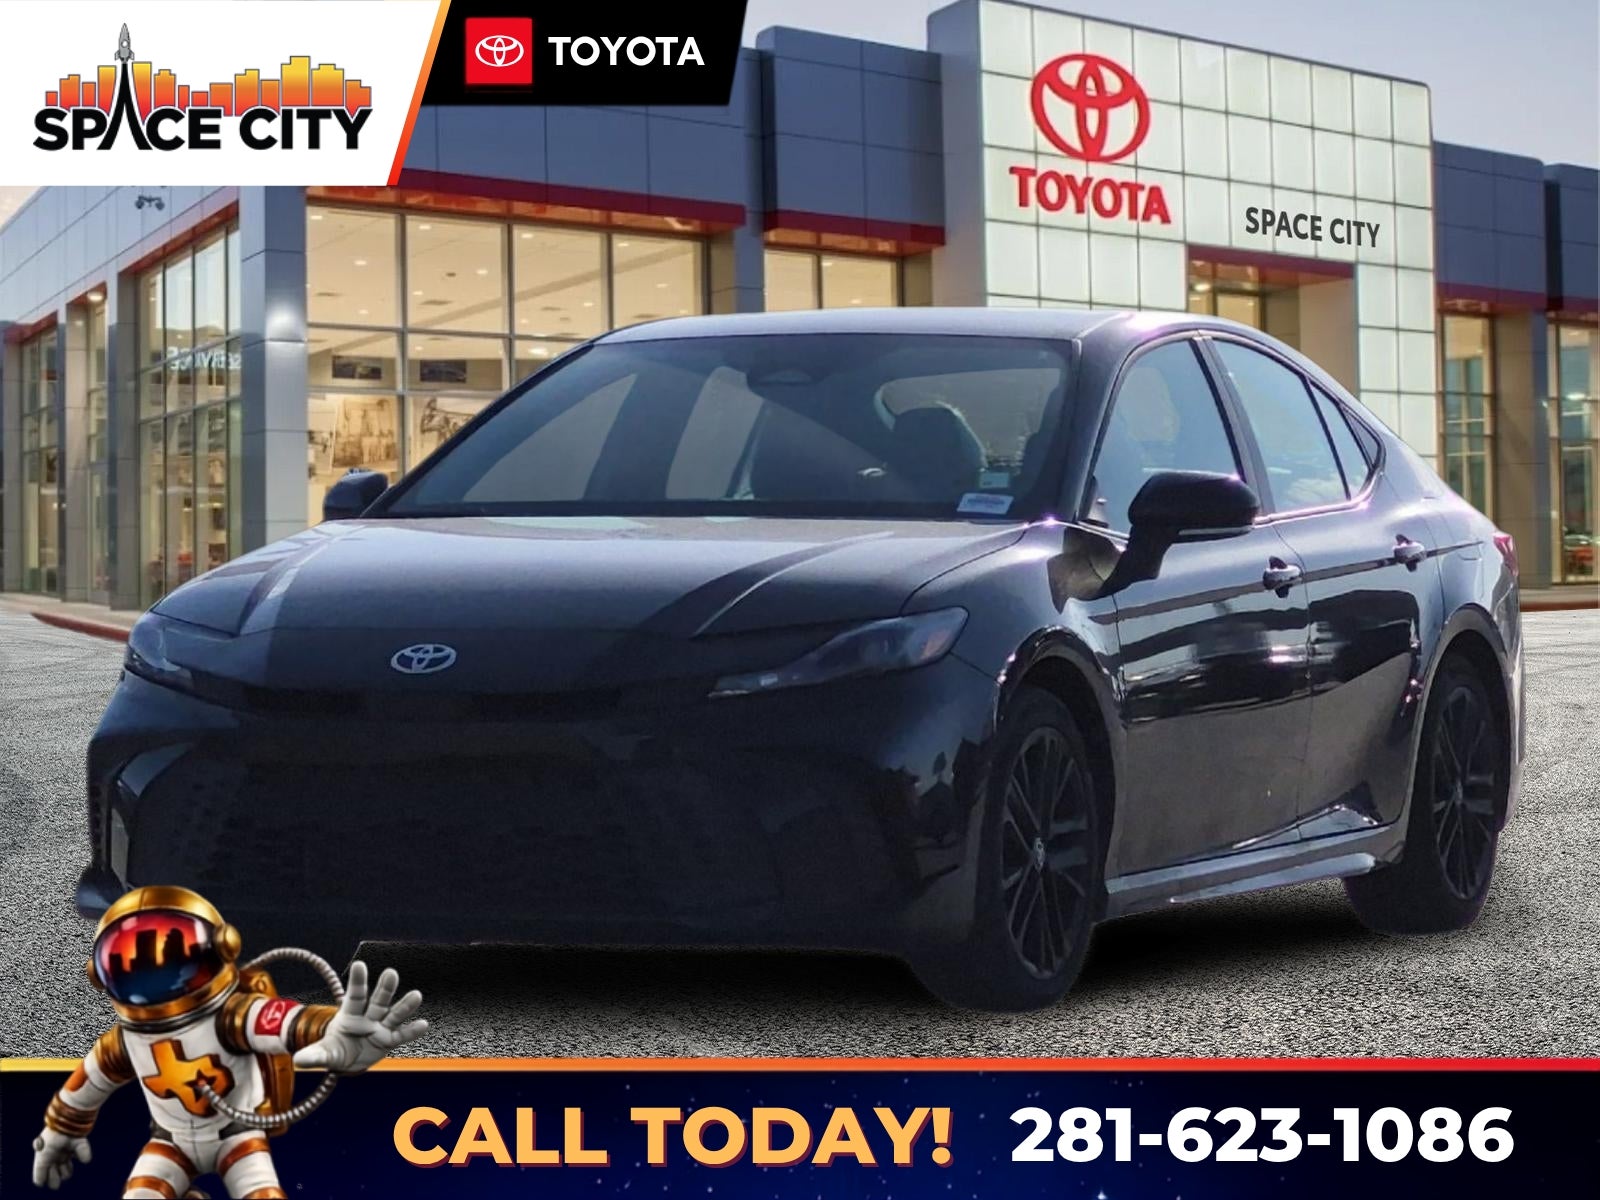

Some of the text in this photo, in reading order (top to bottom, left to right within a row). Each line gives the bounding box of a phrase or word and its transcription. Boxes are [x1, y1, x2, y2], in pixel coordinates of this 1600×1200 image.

[1009, 166, 1171, 224] TOYOTA
[1245, 206, 1381, 248] SPACE CITY
